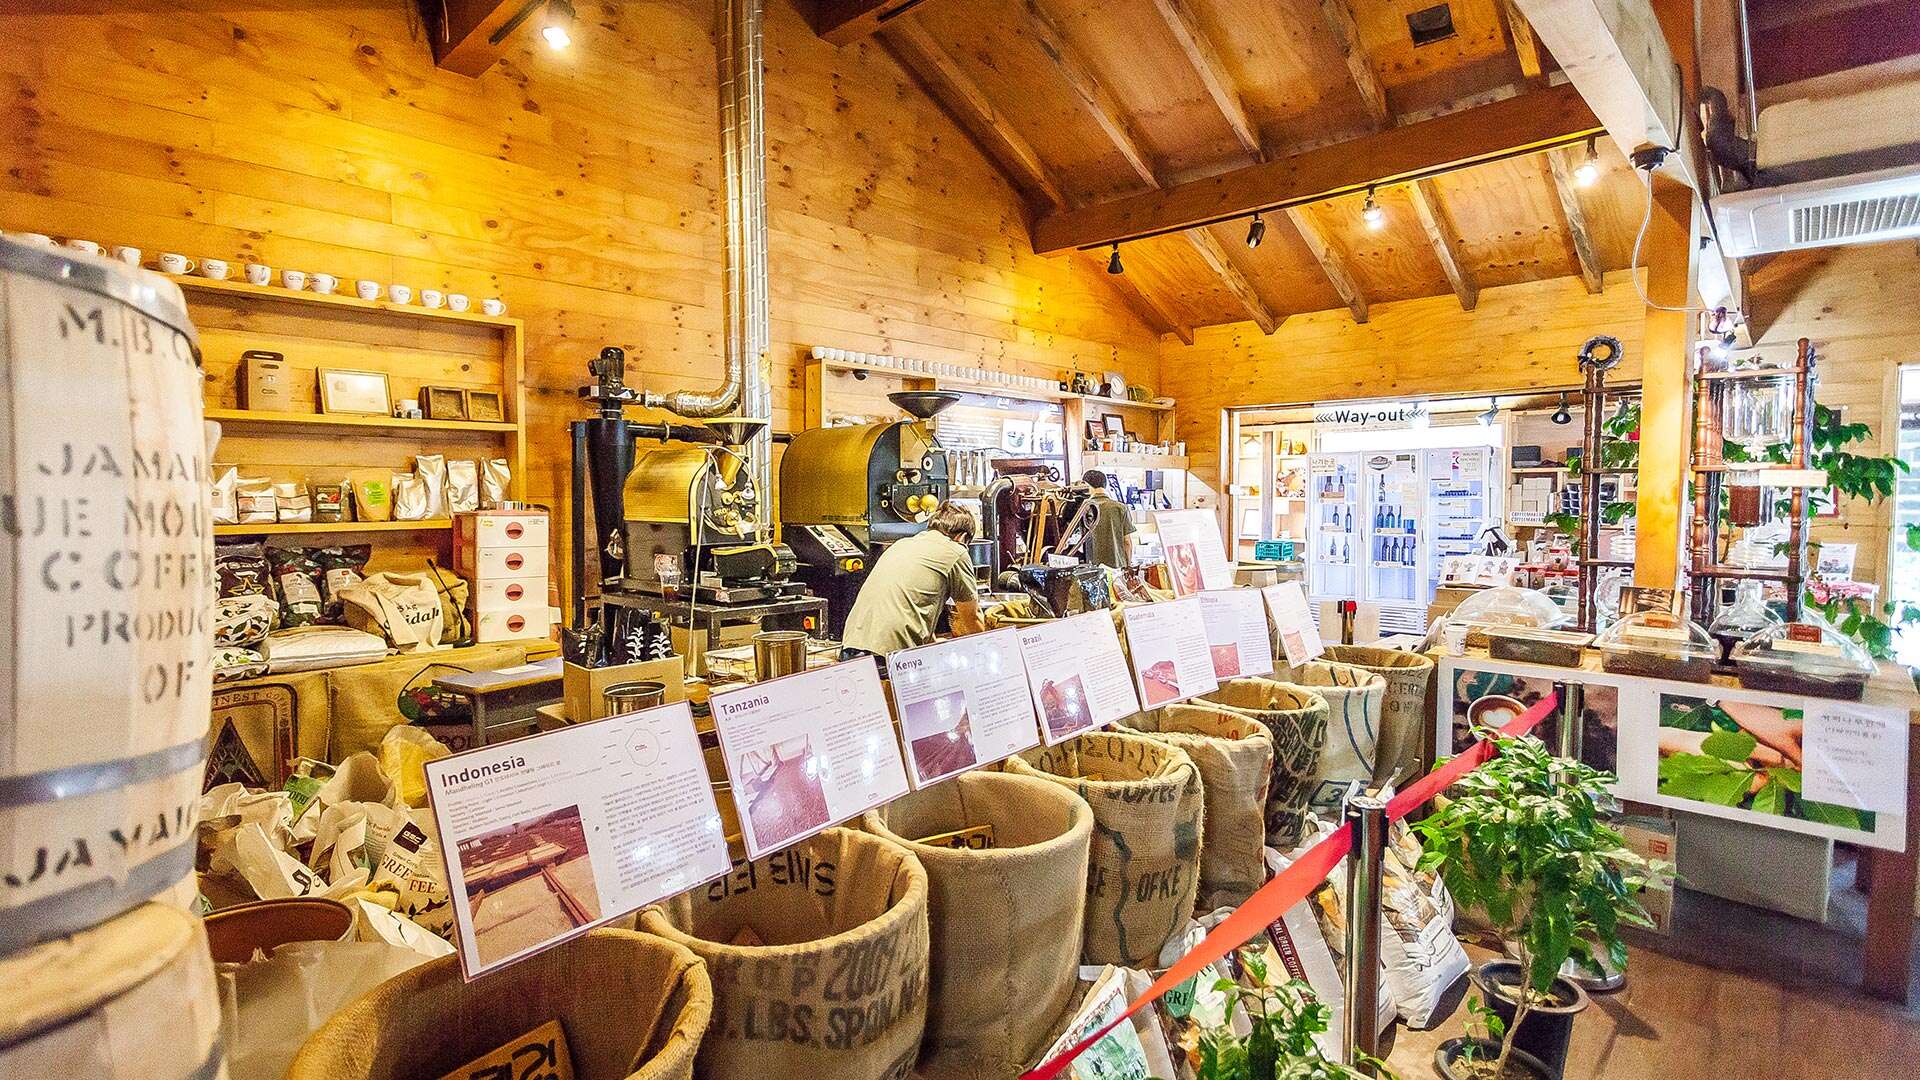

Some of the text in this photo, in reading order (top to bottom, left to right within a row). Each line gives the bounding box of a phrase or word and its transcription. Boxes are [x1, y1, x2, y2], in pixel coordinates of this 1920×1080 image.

[1335, 408, 1404, 425] Way-out
[1022, 633, 1042, 646] Brazil
[895, 658, 923, 672] Kenya
[721, 695, 770, 716] Tanzania
[441, 755, 526, 788] Indonesia
